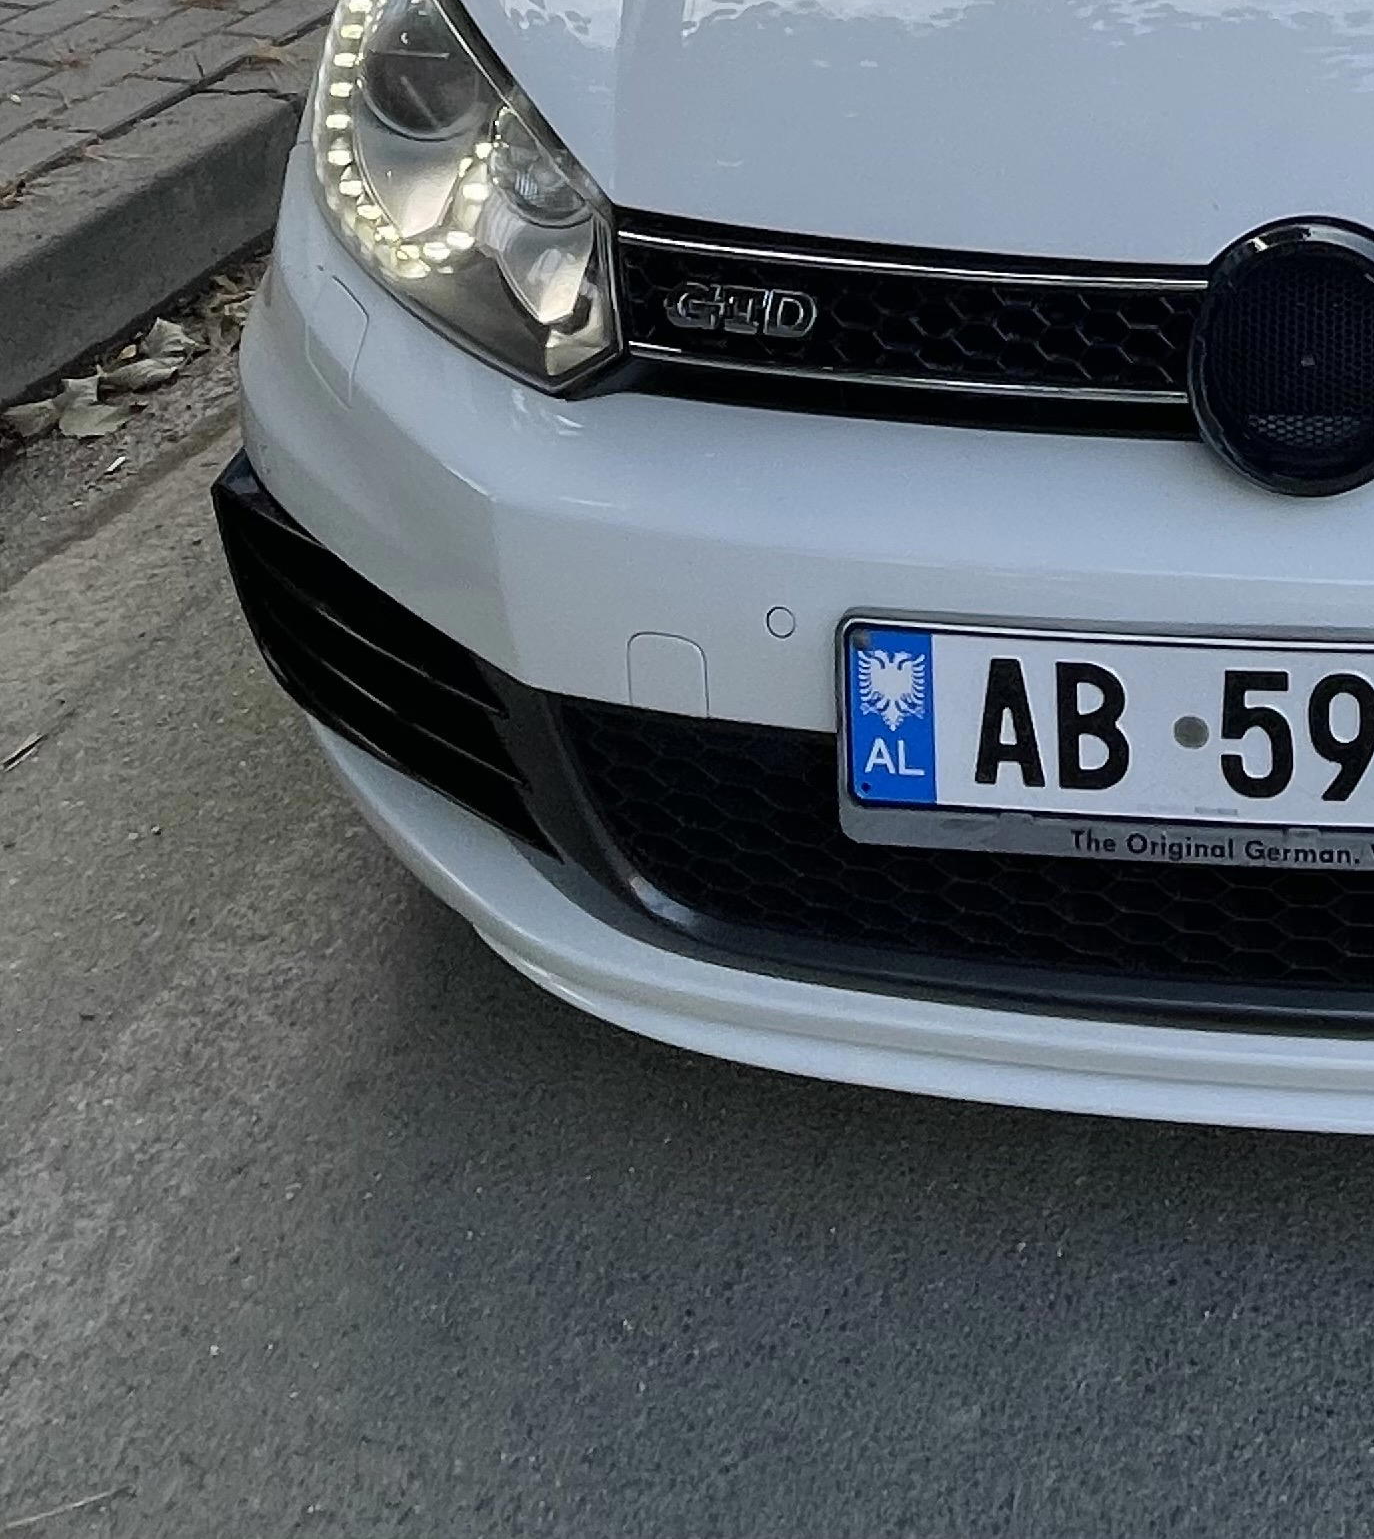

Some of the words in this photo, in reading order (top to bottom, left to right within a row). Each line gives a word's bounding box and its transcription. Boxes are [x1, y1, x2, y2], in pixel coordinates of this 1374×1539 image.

[664, 281, 817, 338] GTD
[974, 657, 1131, 791] AB
[864, 737, 926, 777] AL
[1070, 828, 1117, 853] The
[1126, 831, 1235, 861] Original
